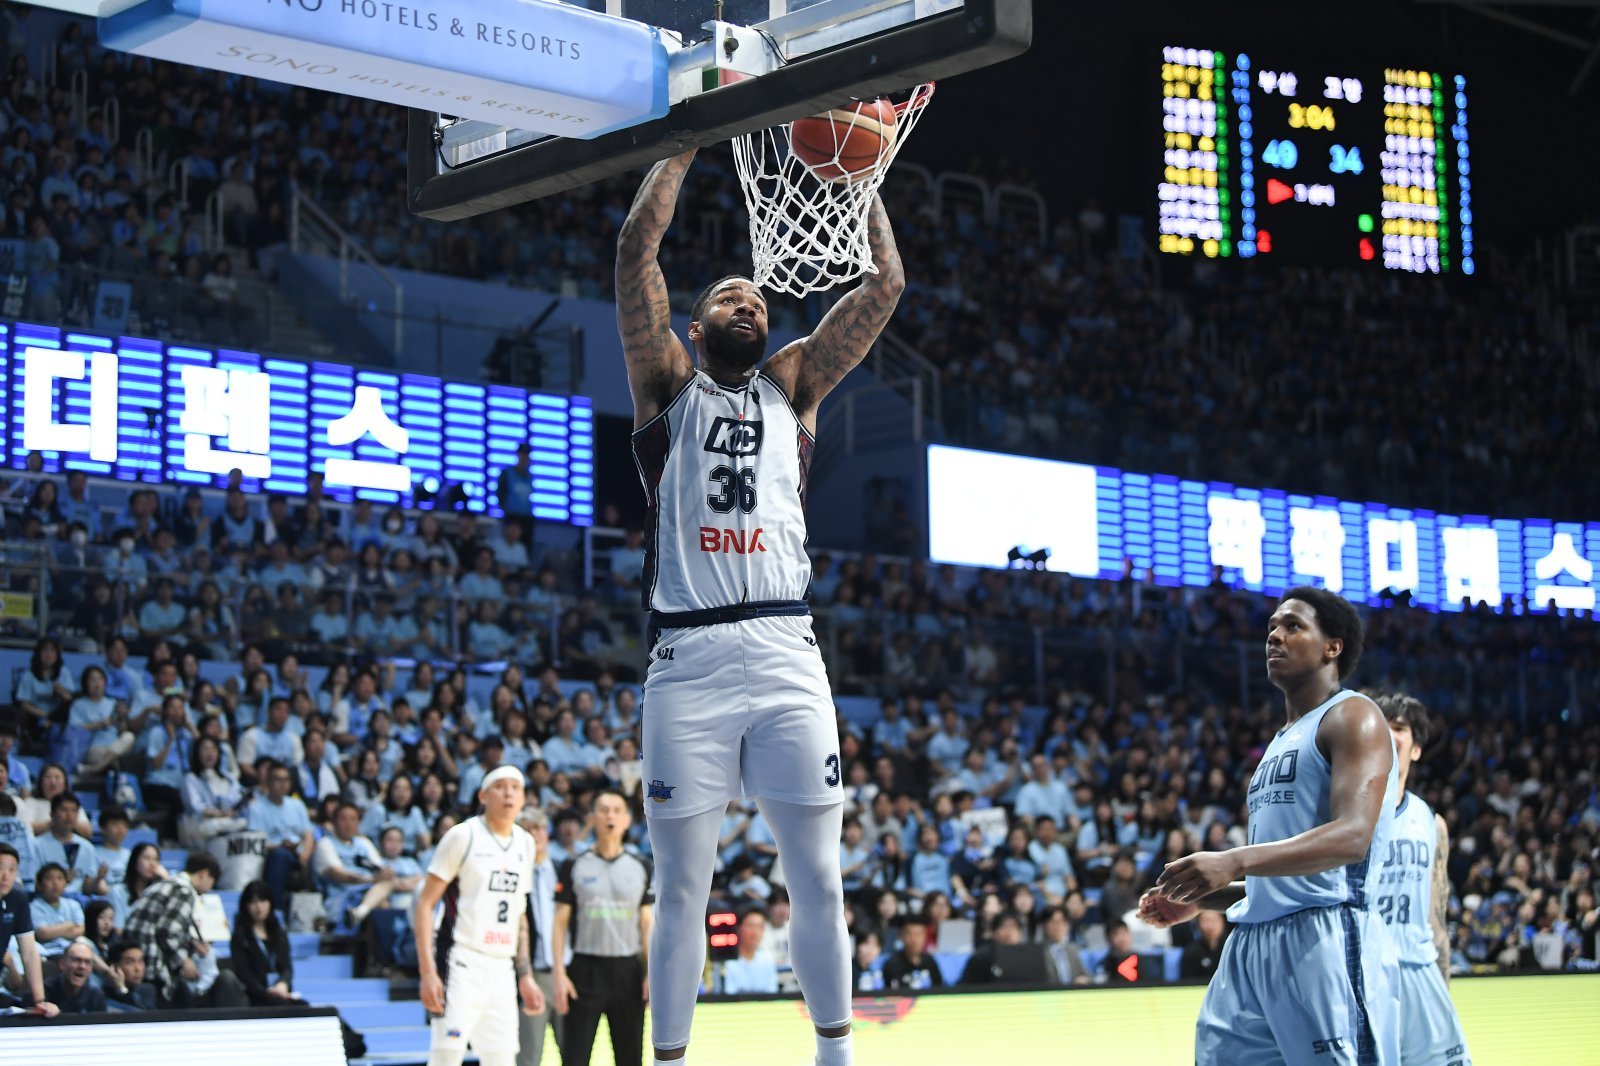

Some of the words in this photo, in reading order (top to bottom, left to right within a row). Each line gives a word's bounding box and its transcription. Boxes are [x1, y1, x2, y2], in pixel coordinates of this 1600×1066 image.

[341, 0, 438, 31] HOTELS
[449, 18, 466, 37] &
[477, 22, 580, 60] RESORTS
[216, 44, 337, 75] SONO
[349, 73, 452, 97] HOTELS
[481, 99, 590, 124] RESORTS
[706, 464, 757, 514] 36
[700, 526, 768, 554] BNK
[825, 752, 841, 788] 3
[497, 900, 509, 923] 2
[1377, 894, 1411, 925] 28
